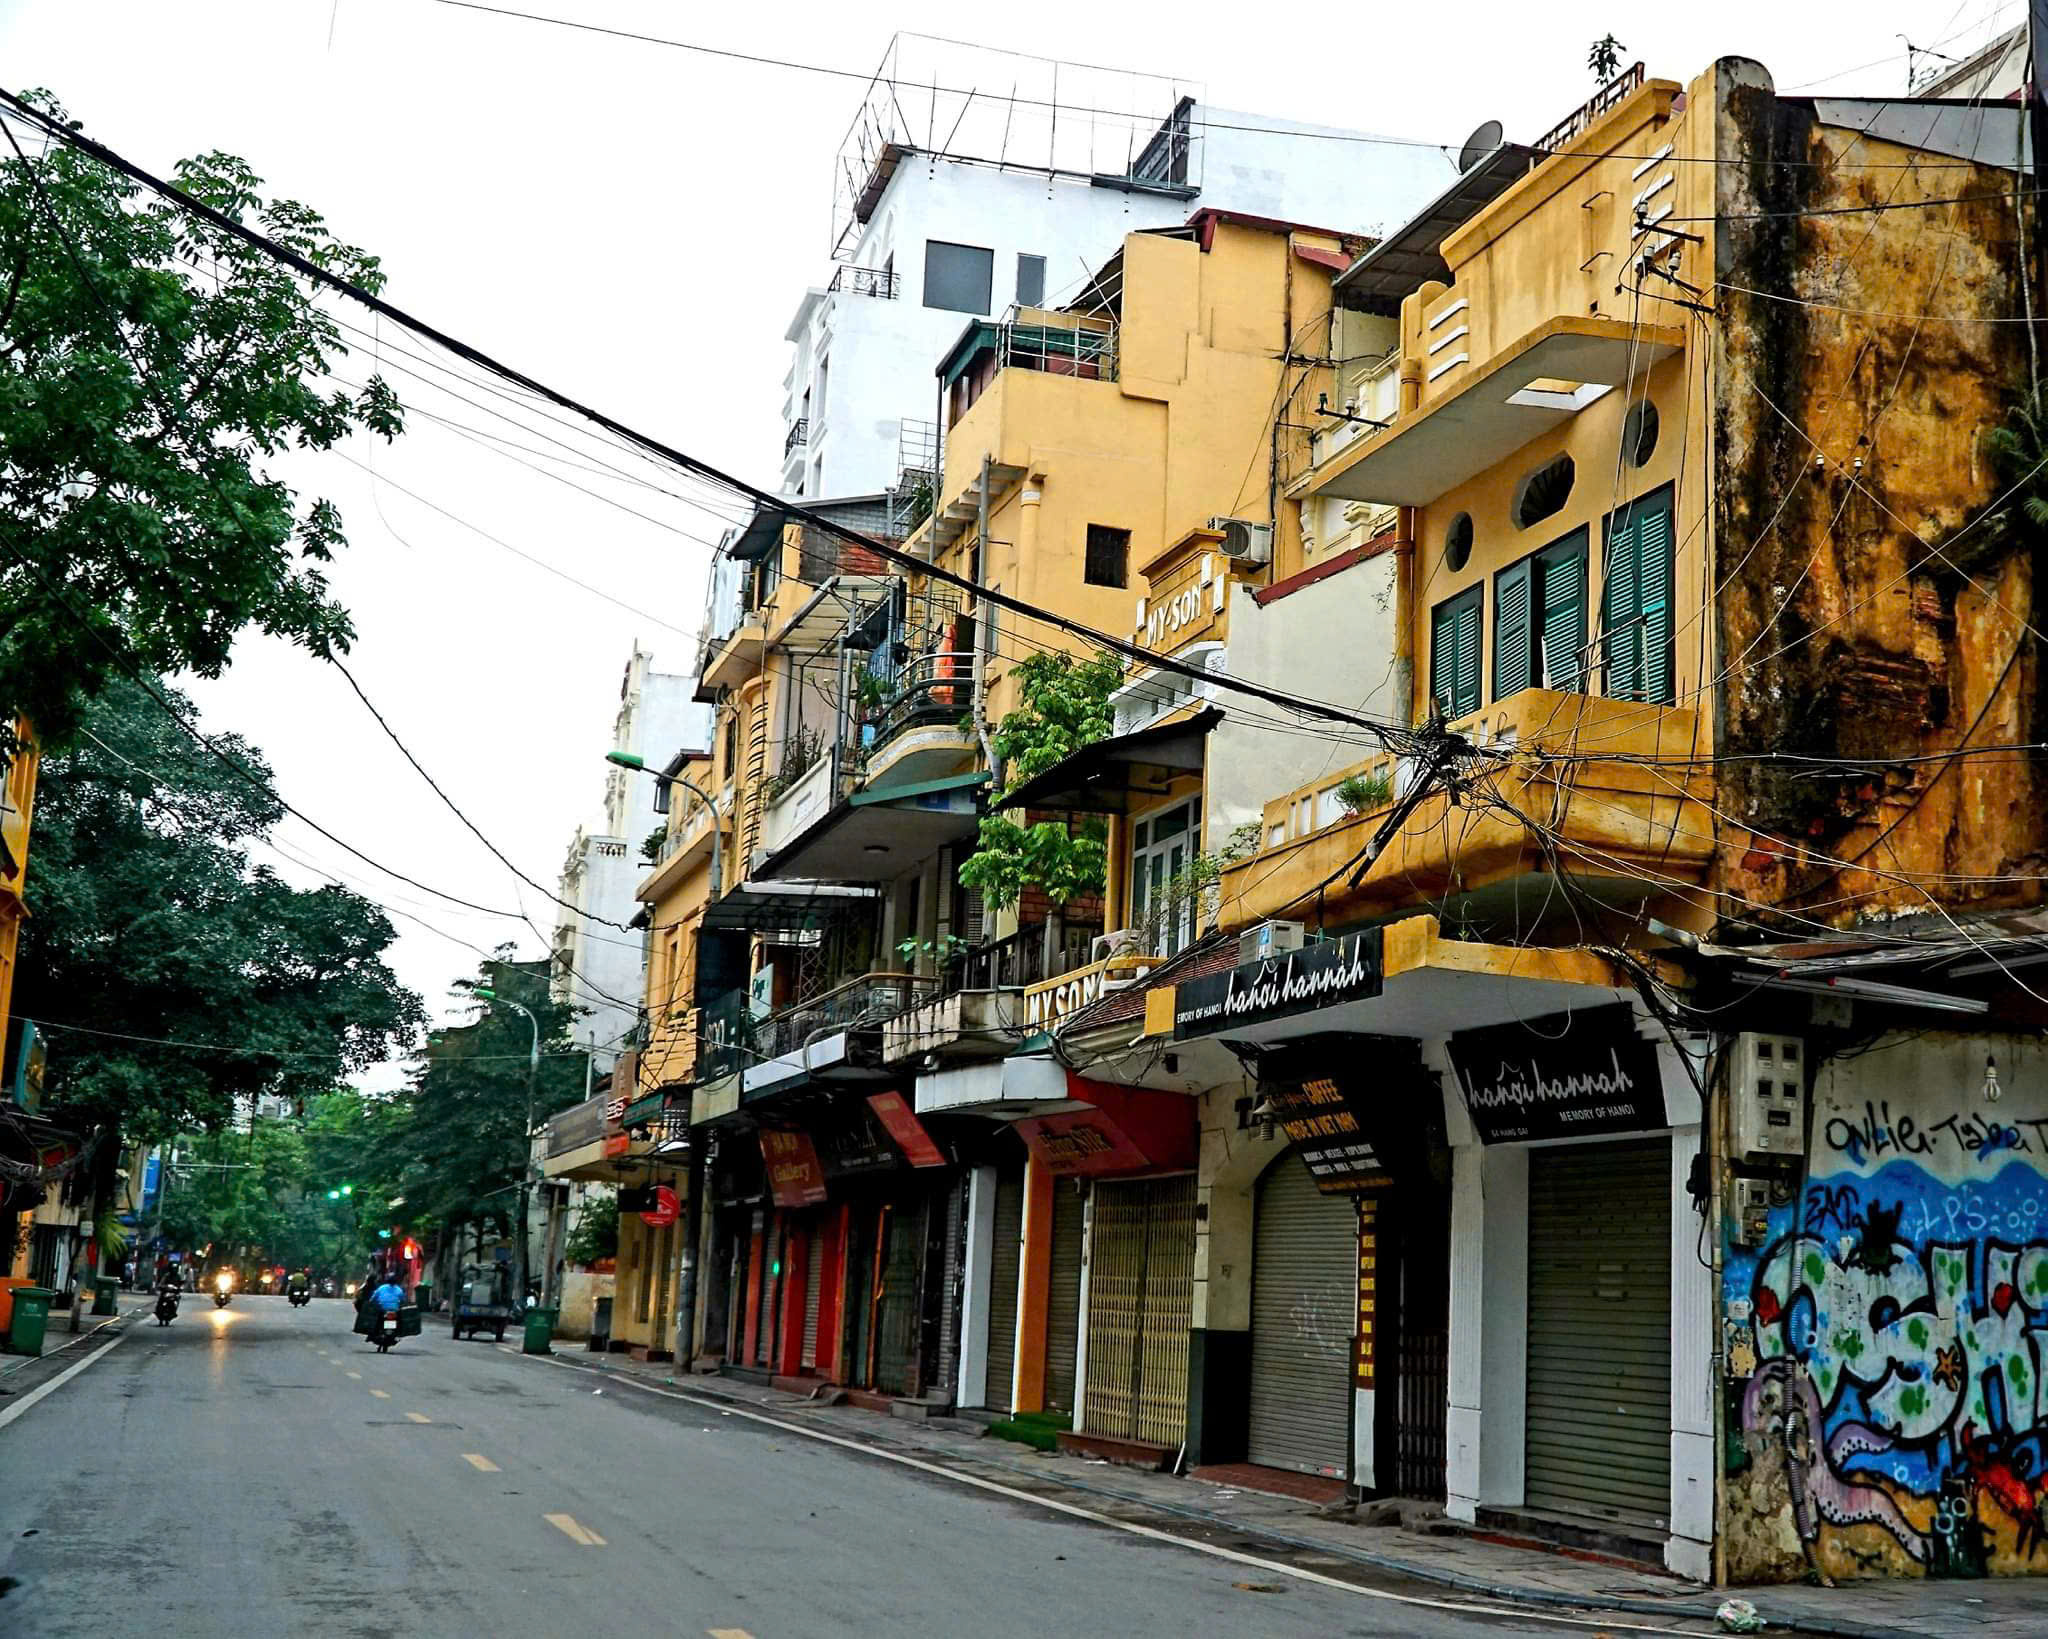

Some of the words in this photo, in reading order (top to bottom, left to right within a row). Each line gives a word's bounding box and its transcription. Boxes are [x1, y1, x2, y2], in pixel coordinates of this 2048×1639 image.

[1195, 1007, 1204, 1020] OF
[1203, 1003, 1222, 1017] HANOI
[1302, 1079, 1344, 1104] COFFEE
[1559, 1108, 1594, 1121] MEMORY
[1595, 1106, 1606, 1118] OF
[1606, 1104, 1636, 1116] HANOI
